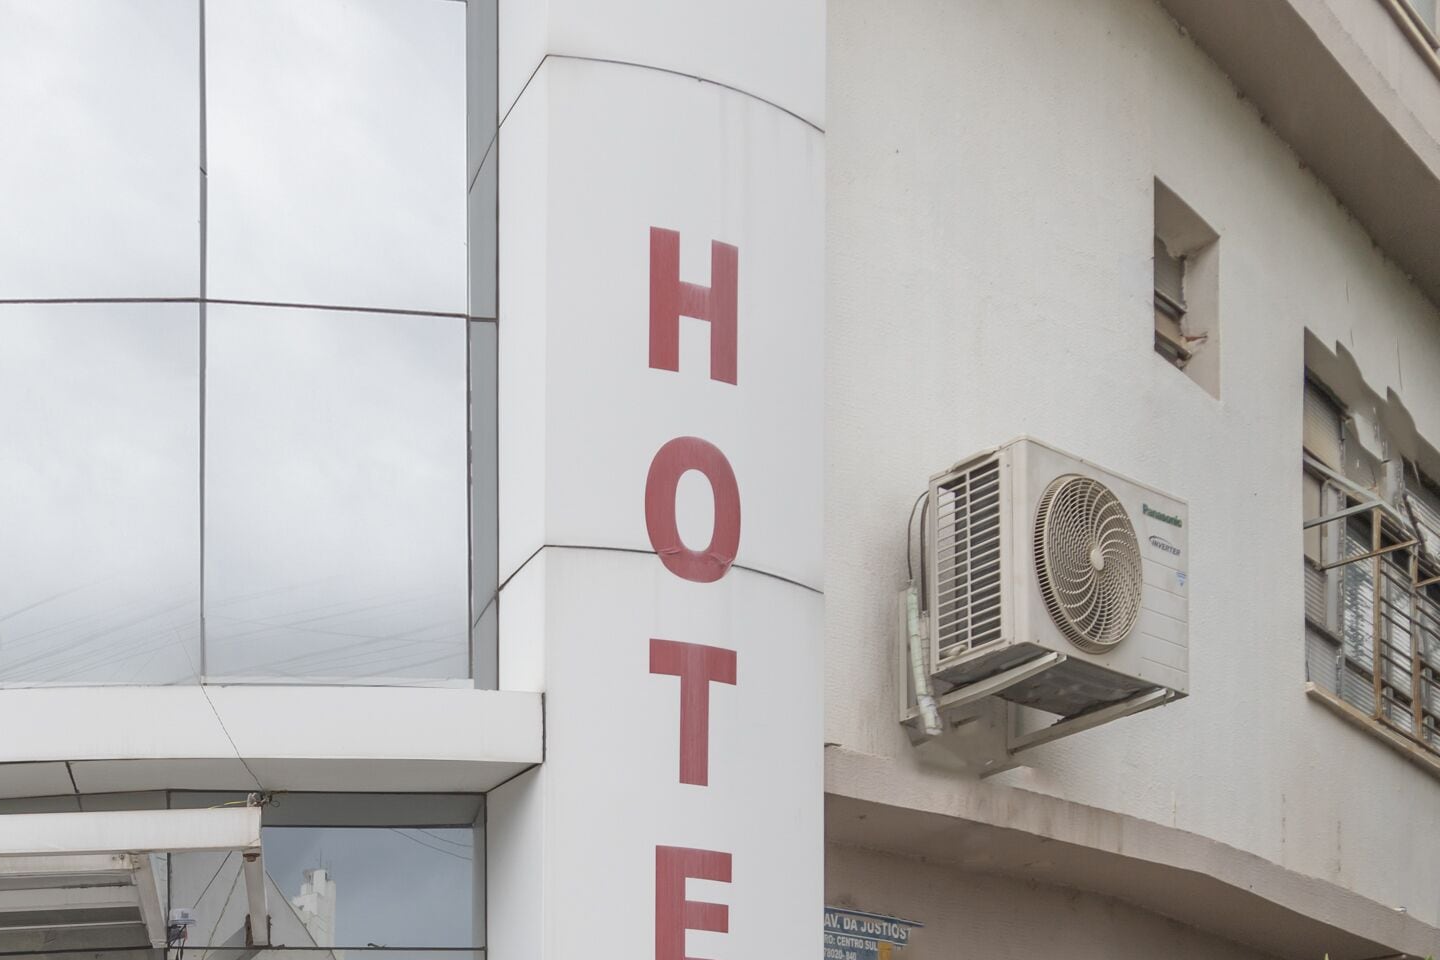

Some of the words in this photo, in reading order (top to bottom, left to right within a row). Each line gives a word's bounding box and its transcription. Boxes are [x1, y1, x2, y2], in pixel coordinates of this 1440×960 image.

[1142, 503, 1183, 528] Panasonic
[1151, 539, 1181, 556] INVERTER
[824, 913, 840, 928] AV.
[843, 917, 858, 931] DA
[836, 936, 864, 949] CENTRO
[864, 940, 879, 951] SUL
